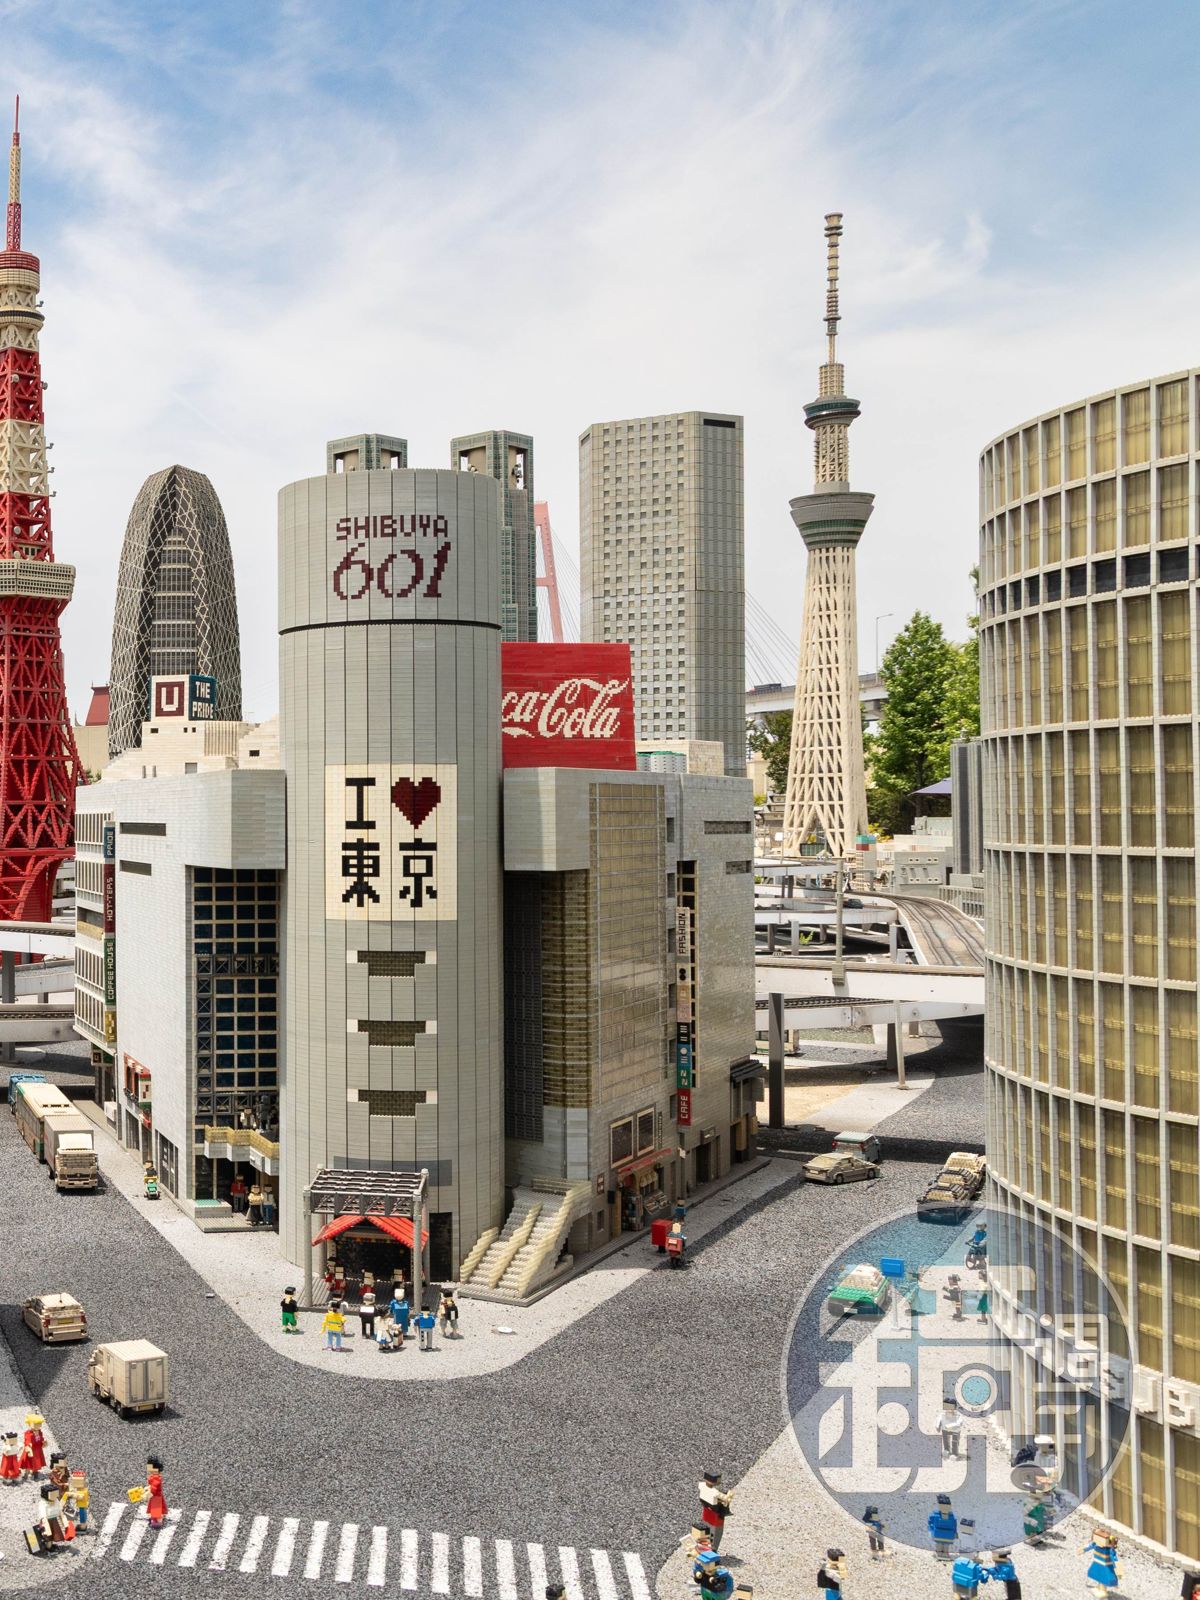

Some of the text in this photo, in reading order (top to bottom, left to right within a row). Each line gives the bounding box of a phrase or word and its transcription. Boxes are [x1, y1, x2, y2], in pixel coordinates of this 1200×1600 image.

[336, 515, 447, 540] SHIBUYA
[160, 686, 179, 712] U
[195, 681, 211, 699] THE
[192, 701, 214, 719] PRIDE
[500, 677, 629, 738] ca-Cola
[345, 777, 376, 830] I
[341, 838, 437, 908] 東京
